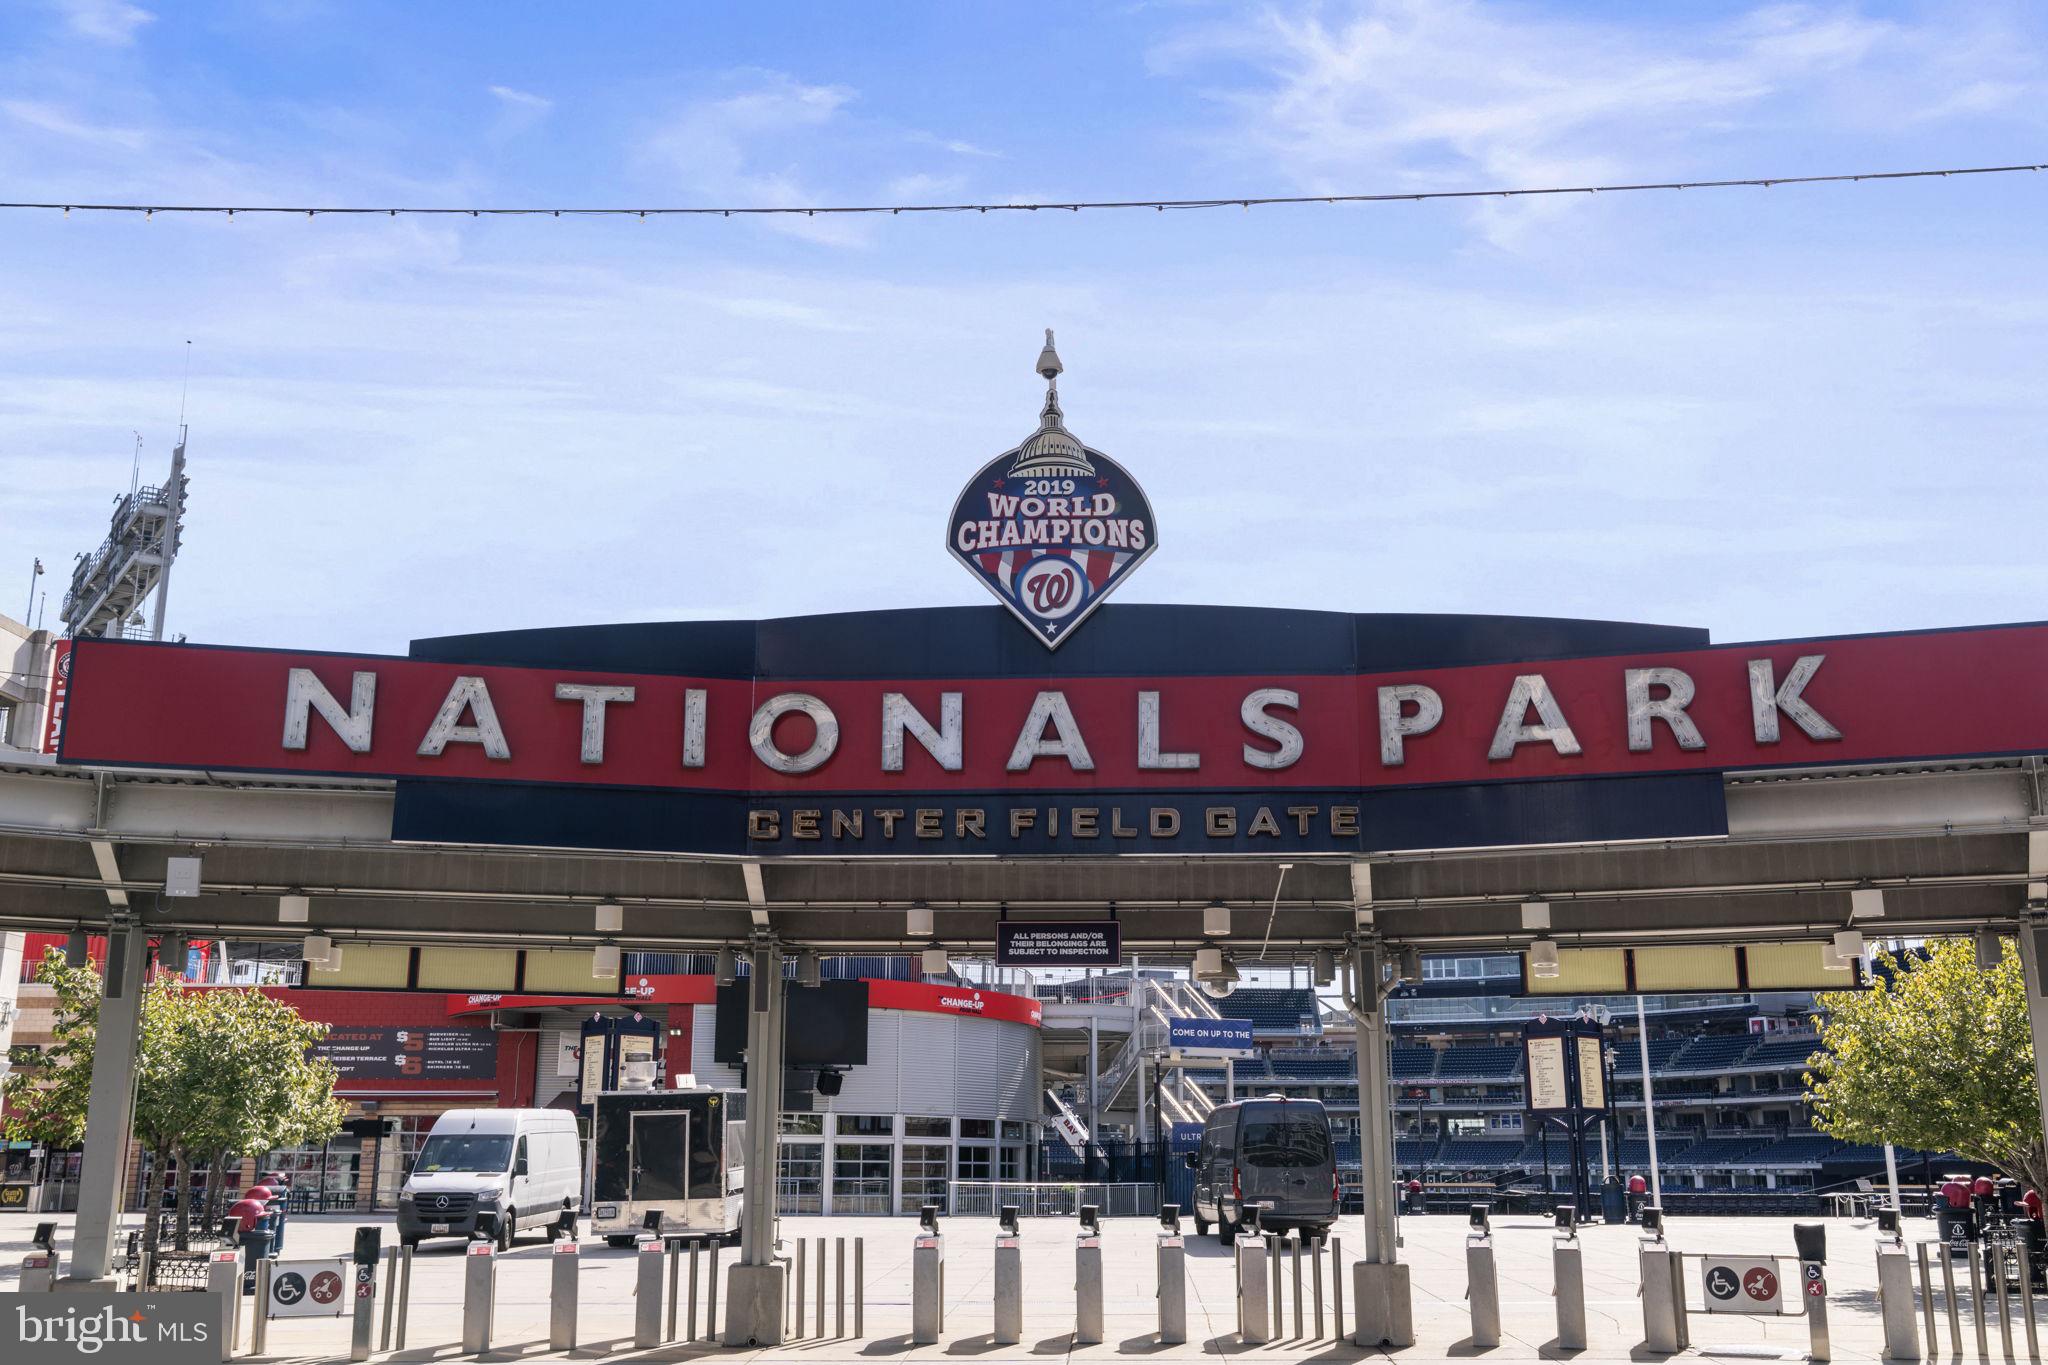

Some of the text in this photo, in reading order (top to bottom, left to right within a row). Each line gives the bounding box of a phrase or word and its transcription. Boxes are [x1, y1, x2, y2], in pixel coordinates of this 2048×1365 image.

[1024, 479, 1076, 496] 2019
[987, 492, 1116, 518] WORLD
[957, 519, 1146, 552] CHAMPIONS
[282, 654, 1843, 775] NATIONALS PARK
[748, 806, 1360, 839] CENTER FIELD GATE
[1010, 940, 1107, 948] THEIR BELONGINGS ARE
[1013, 932, 1104, 940] ALL PERSONS AND/OR
[1008, 948, 1109, 956] SUBJECT TO INSPECTION
[941, 997, 984, 1009] CHANGE-UP
[1172, 1028, 1195, 1037] COME
[1196, 1029, 1209, 1037] ON
[1210, 1030, 1221, 1038] UP
[1235, 1031, 1250, 1039] THE
[1063, 1118, 1078, 1136] BAY
